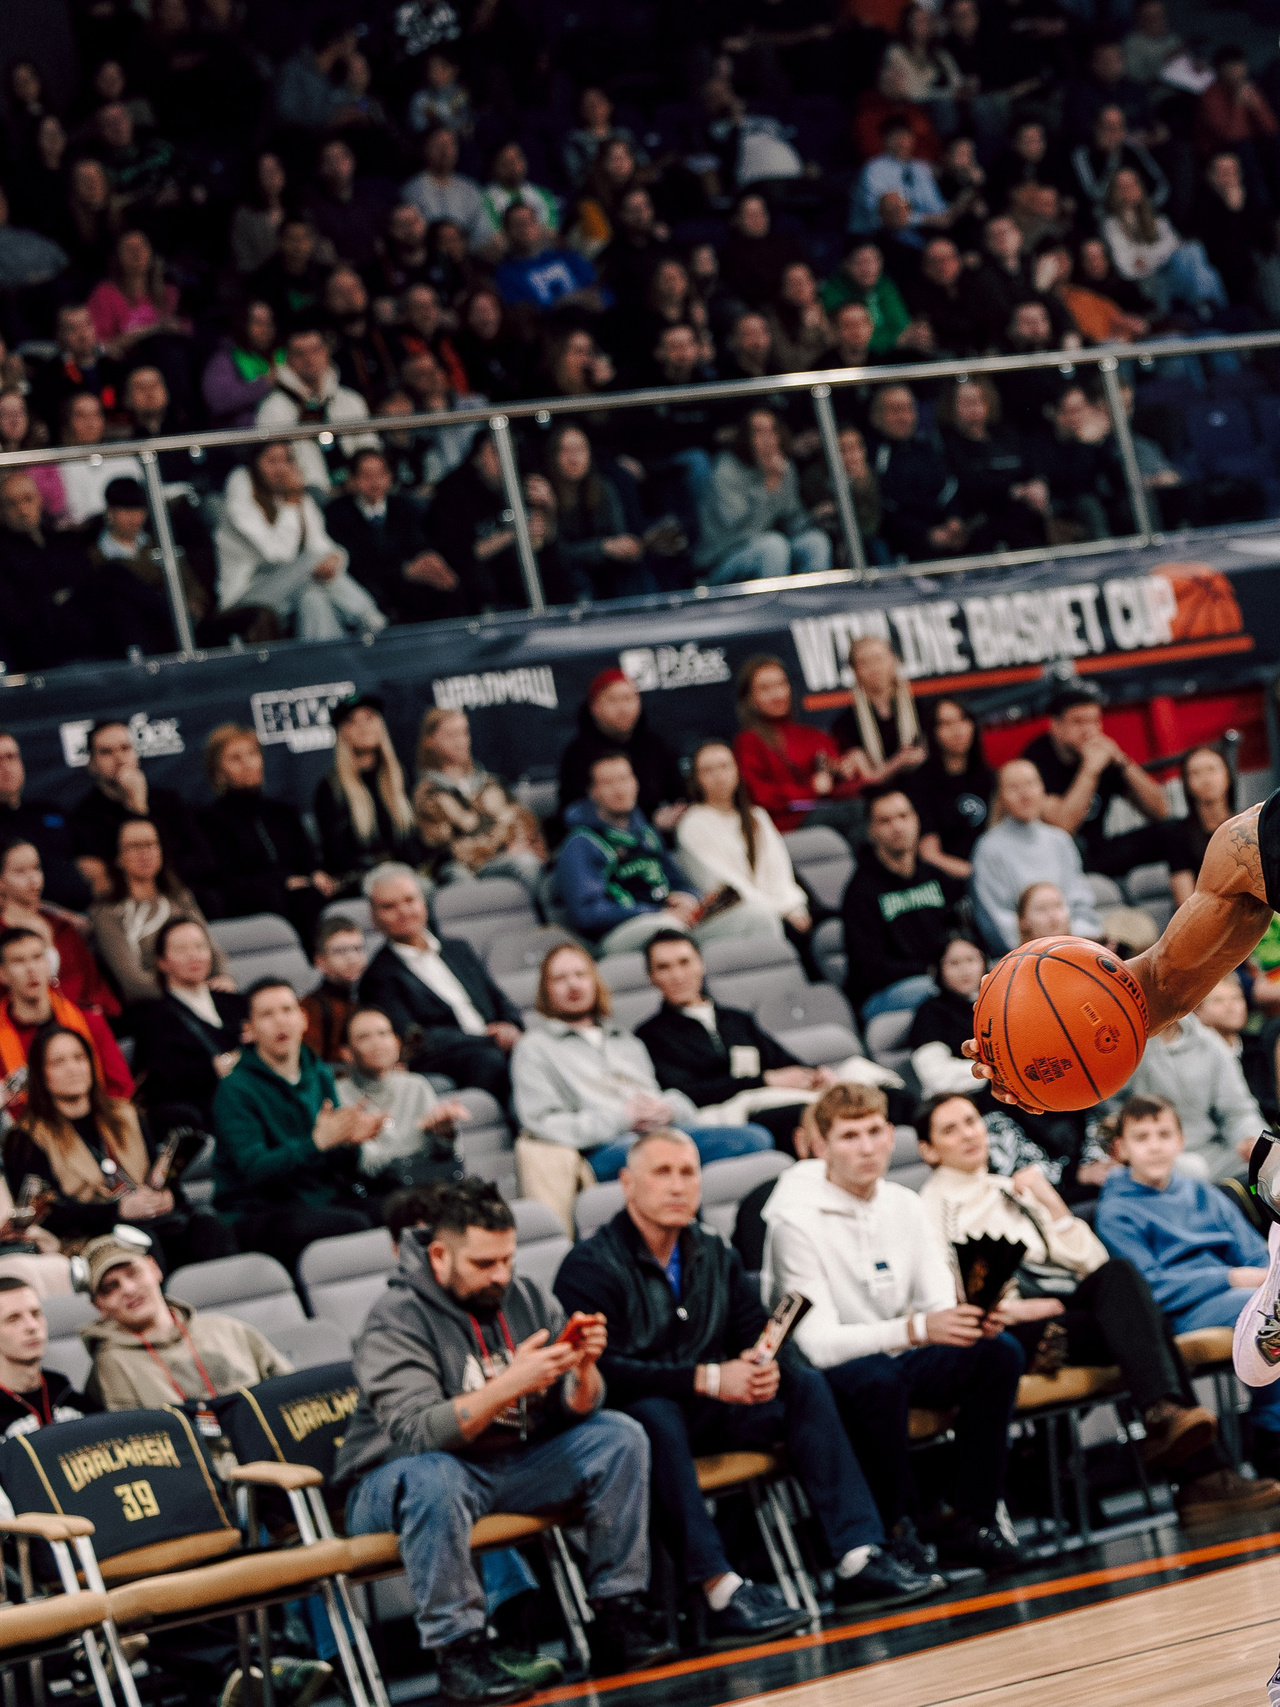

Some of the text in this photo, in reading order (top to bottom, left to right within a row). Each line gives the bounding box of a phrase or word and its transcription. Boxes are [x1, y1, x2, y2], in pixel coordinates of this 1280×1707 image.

[965, 583, 1105, 669] BASKET
[1103, 575, 1178, 650] CUP
[280, 1390, 359, 1442] URALM
[59, 1433, 181, 1492] URALMASH
[114, 1480, 160, 1521] 39
